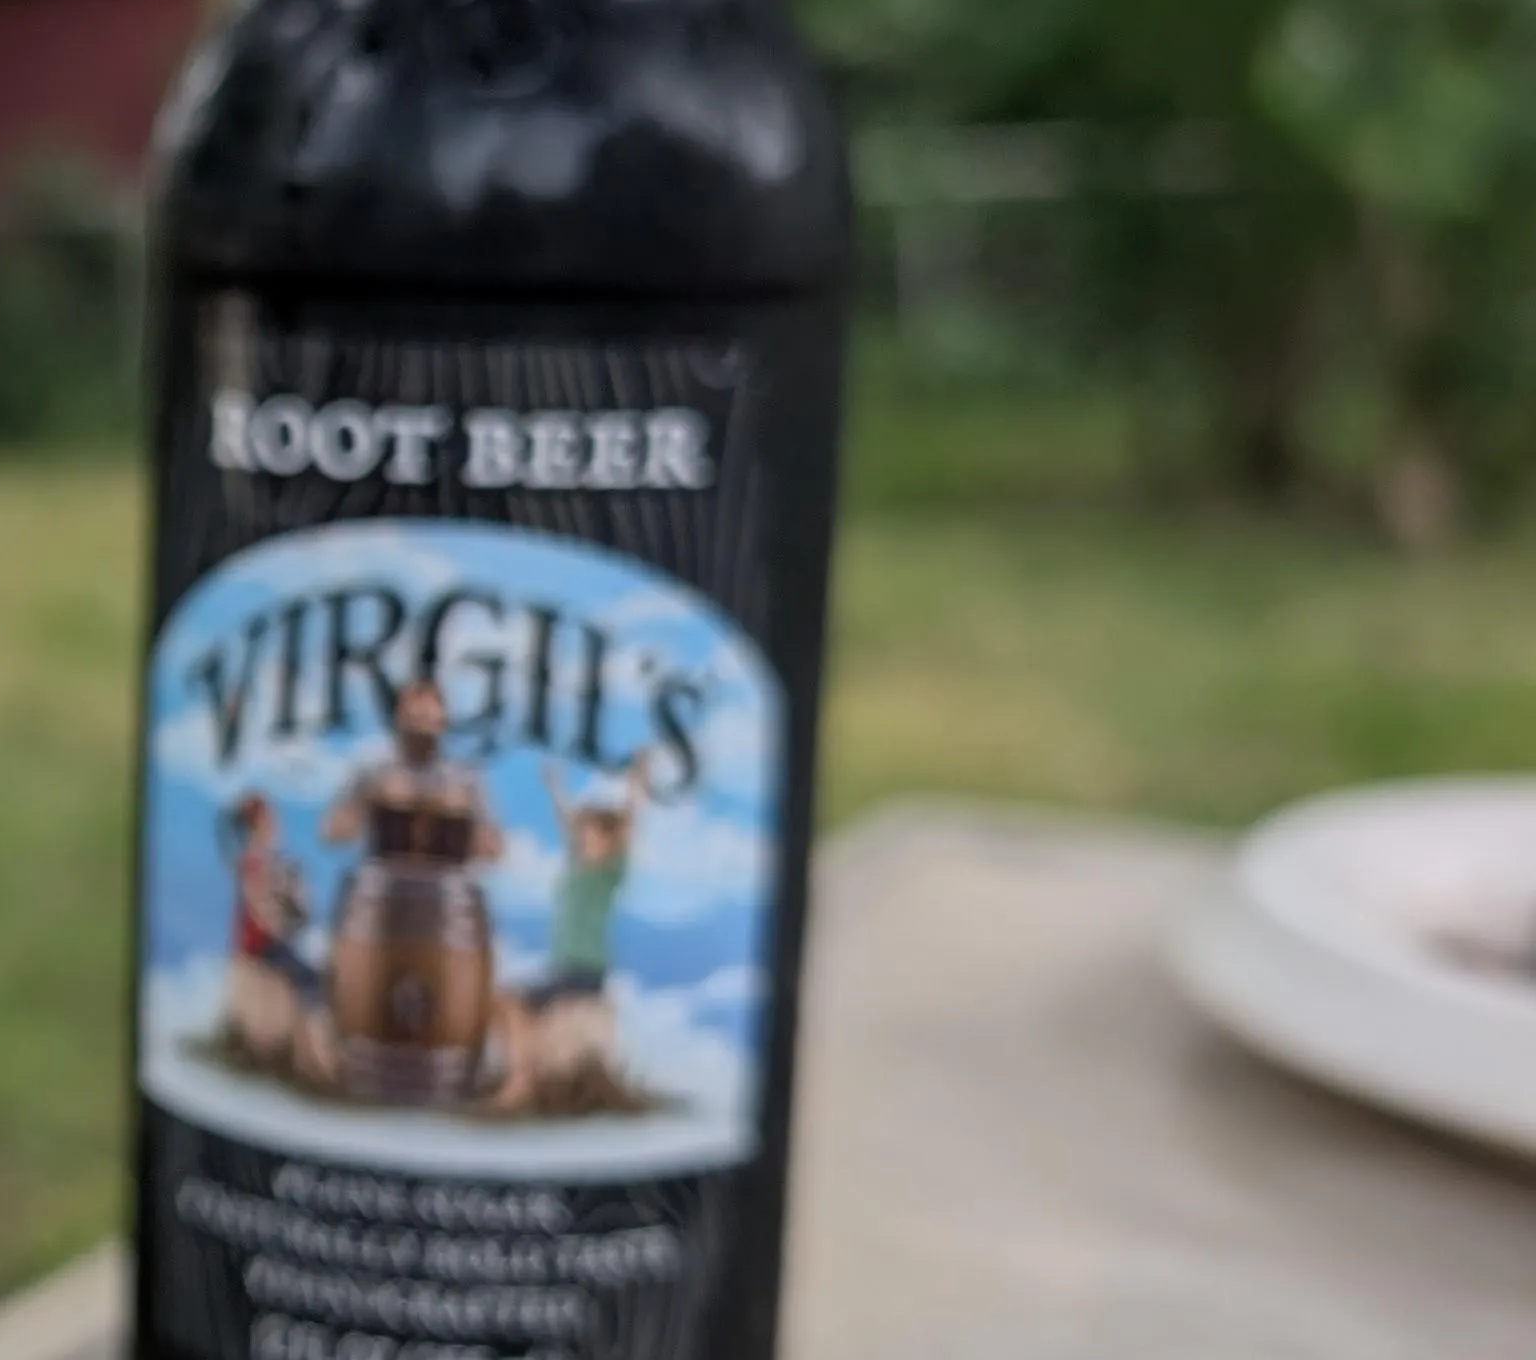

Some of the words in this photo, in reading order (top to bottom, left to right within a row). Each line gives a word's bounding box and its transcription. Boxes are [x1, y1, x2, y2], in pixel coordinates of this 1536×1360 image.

[209, 392, 454, 486] ROOT
[462, 406, 716, 490] BEER
[186, 574, 710, 802] VIRGIL'S
